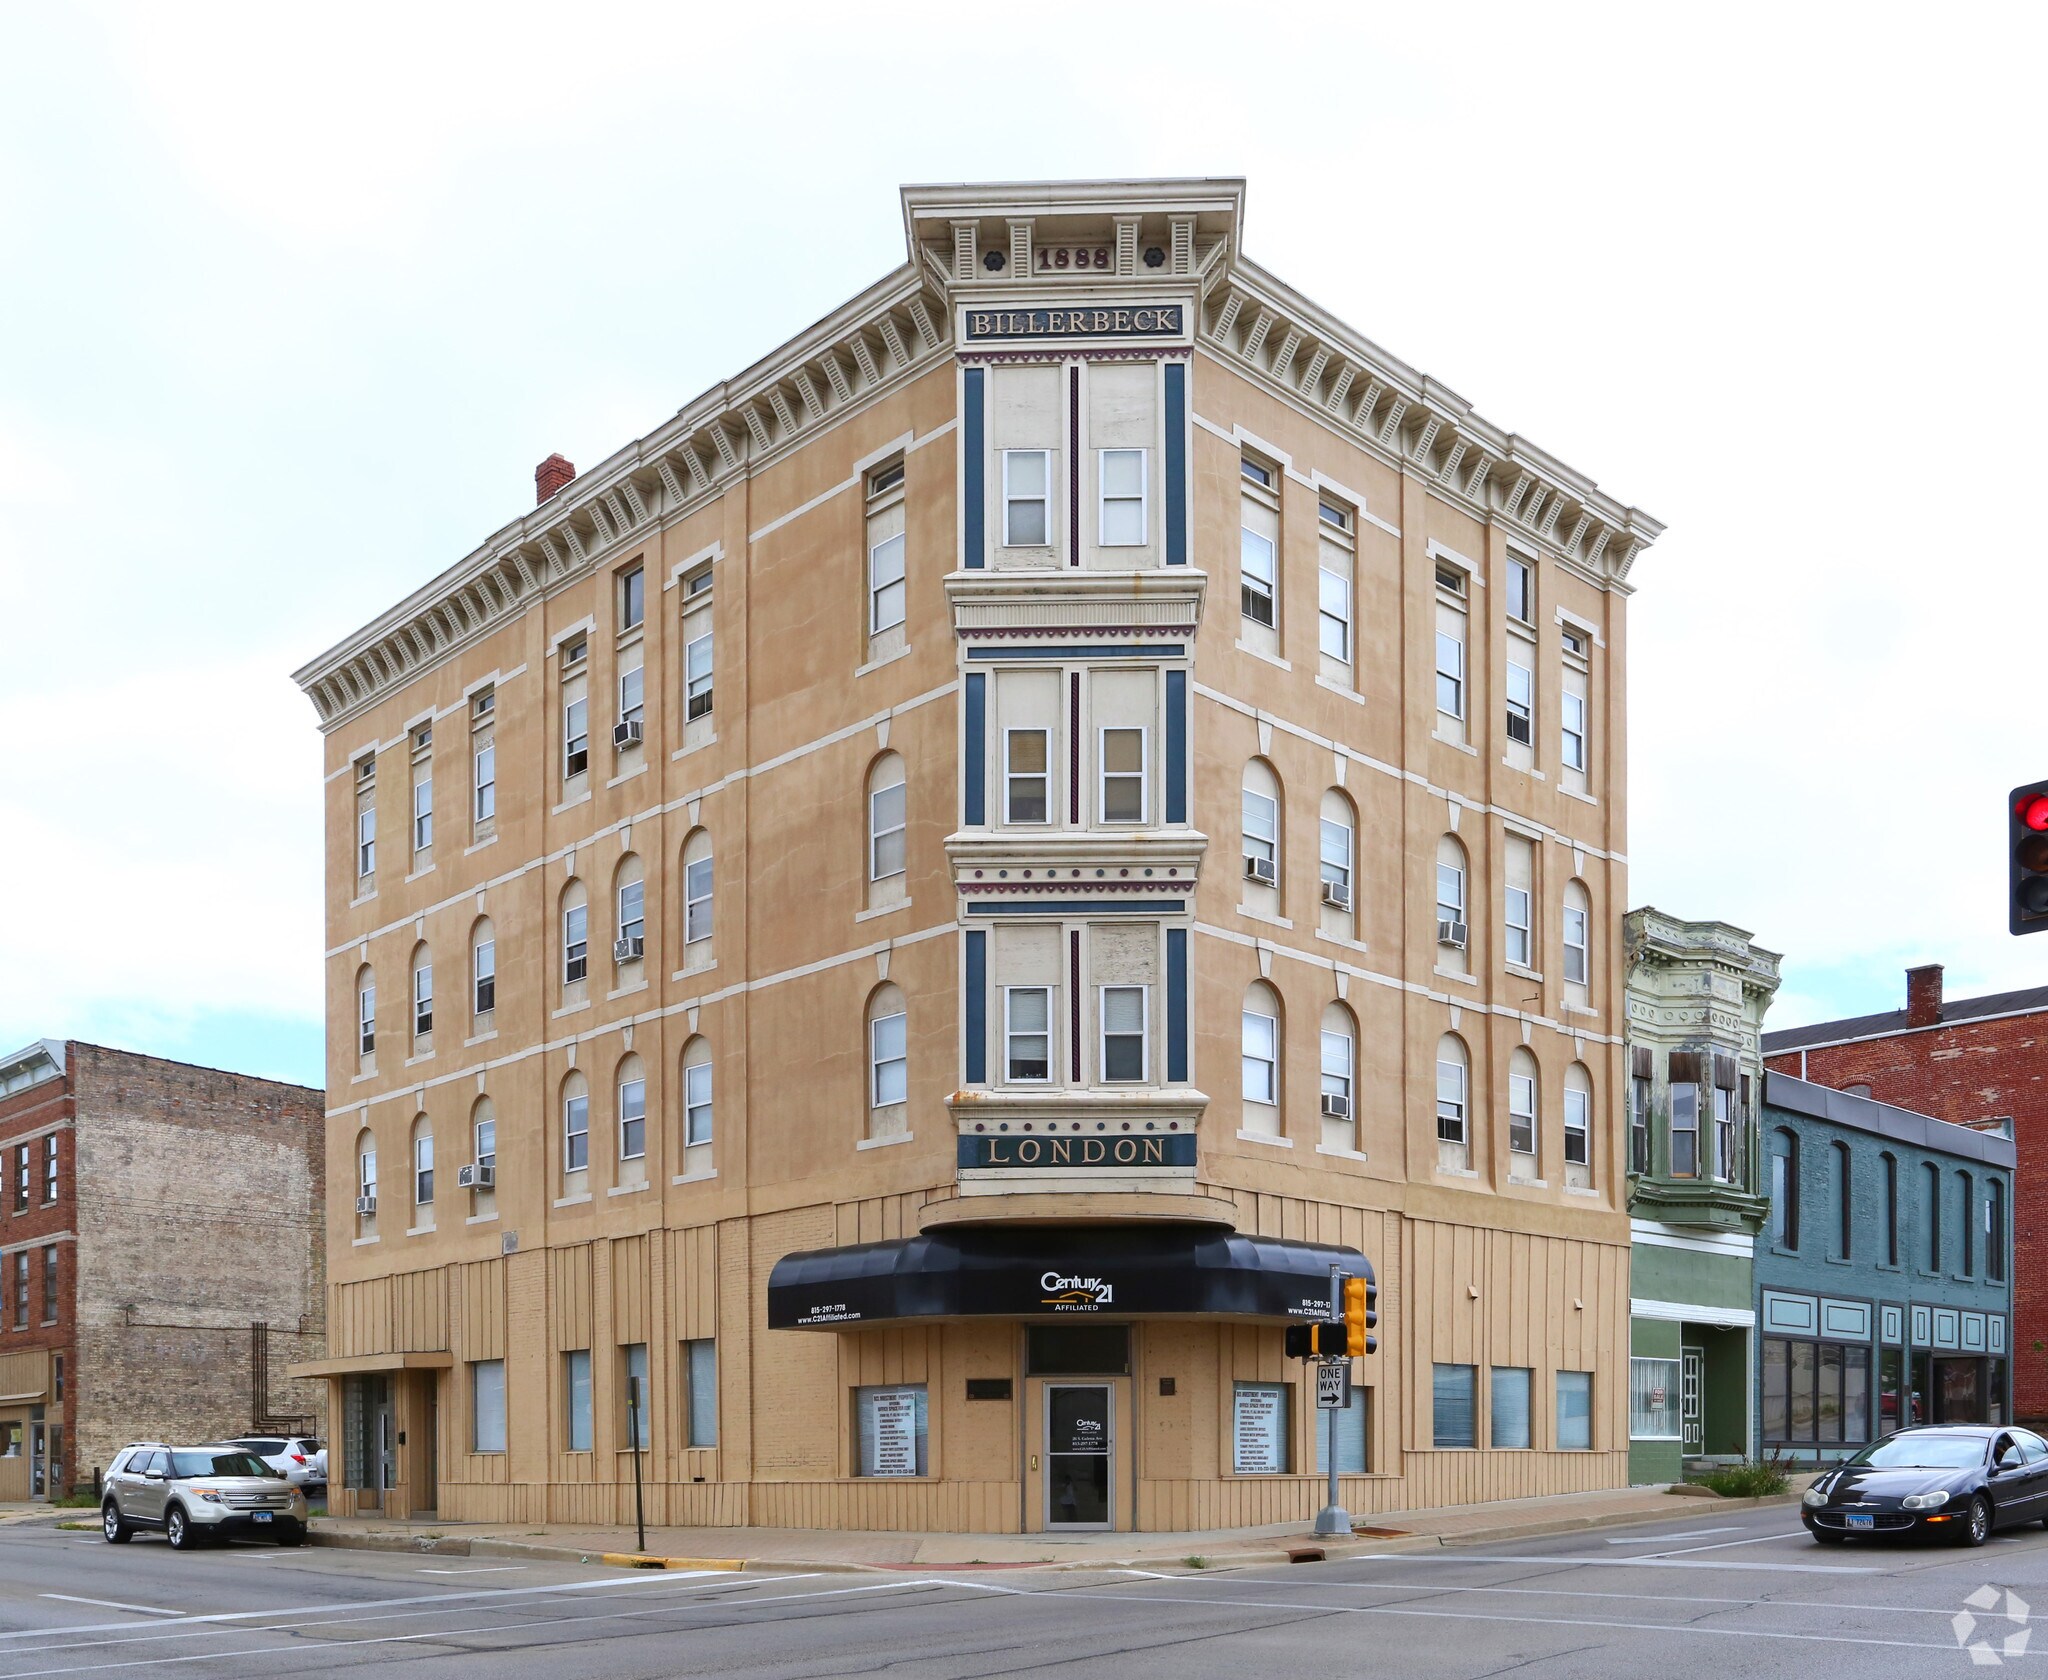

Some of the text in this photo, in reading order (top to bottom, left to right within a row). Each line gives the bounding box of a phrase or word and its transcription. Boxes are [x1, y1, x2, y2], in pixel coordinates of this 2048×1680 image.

[1038, 247, 1110, 270] 1888
[971, 308, 1177, 335] BILLERBECK
[987, 1138, 1165, 1164] LONDON
[1041, 1271, 1113, 1303] Century 21
[811, 1304, 846, 1314] 815-297-1778
[1302, 1299, 1331, 1308] 815-297-17
[797, 1312, 861, 1324] www.C21Affiliated.com
[1320, 1368, 1341, 1379] ONE
[1320, 1380, 1341, 1391] WAY
